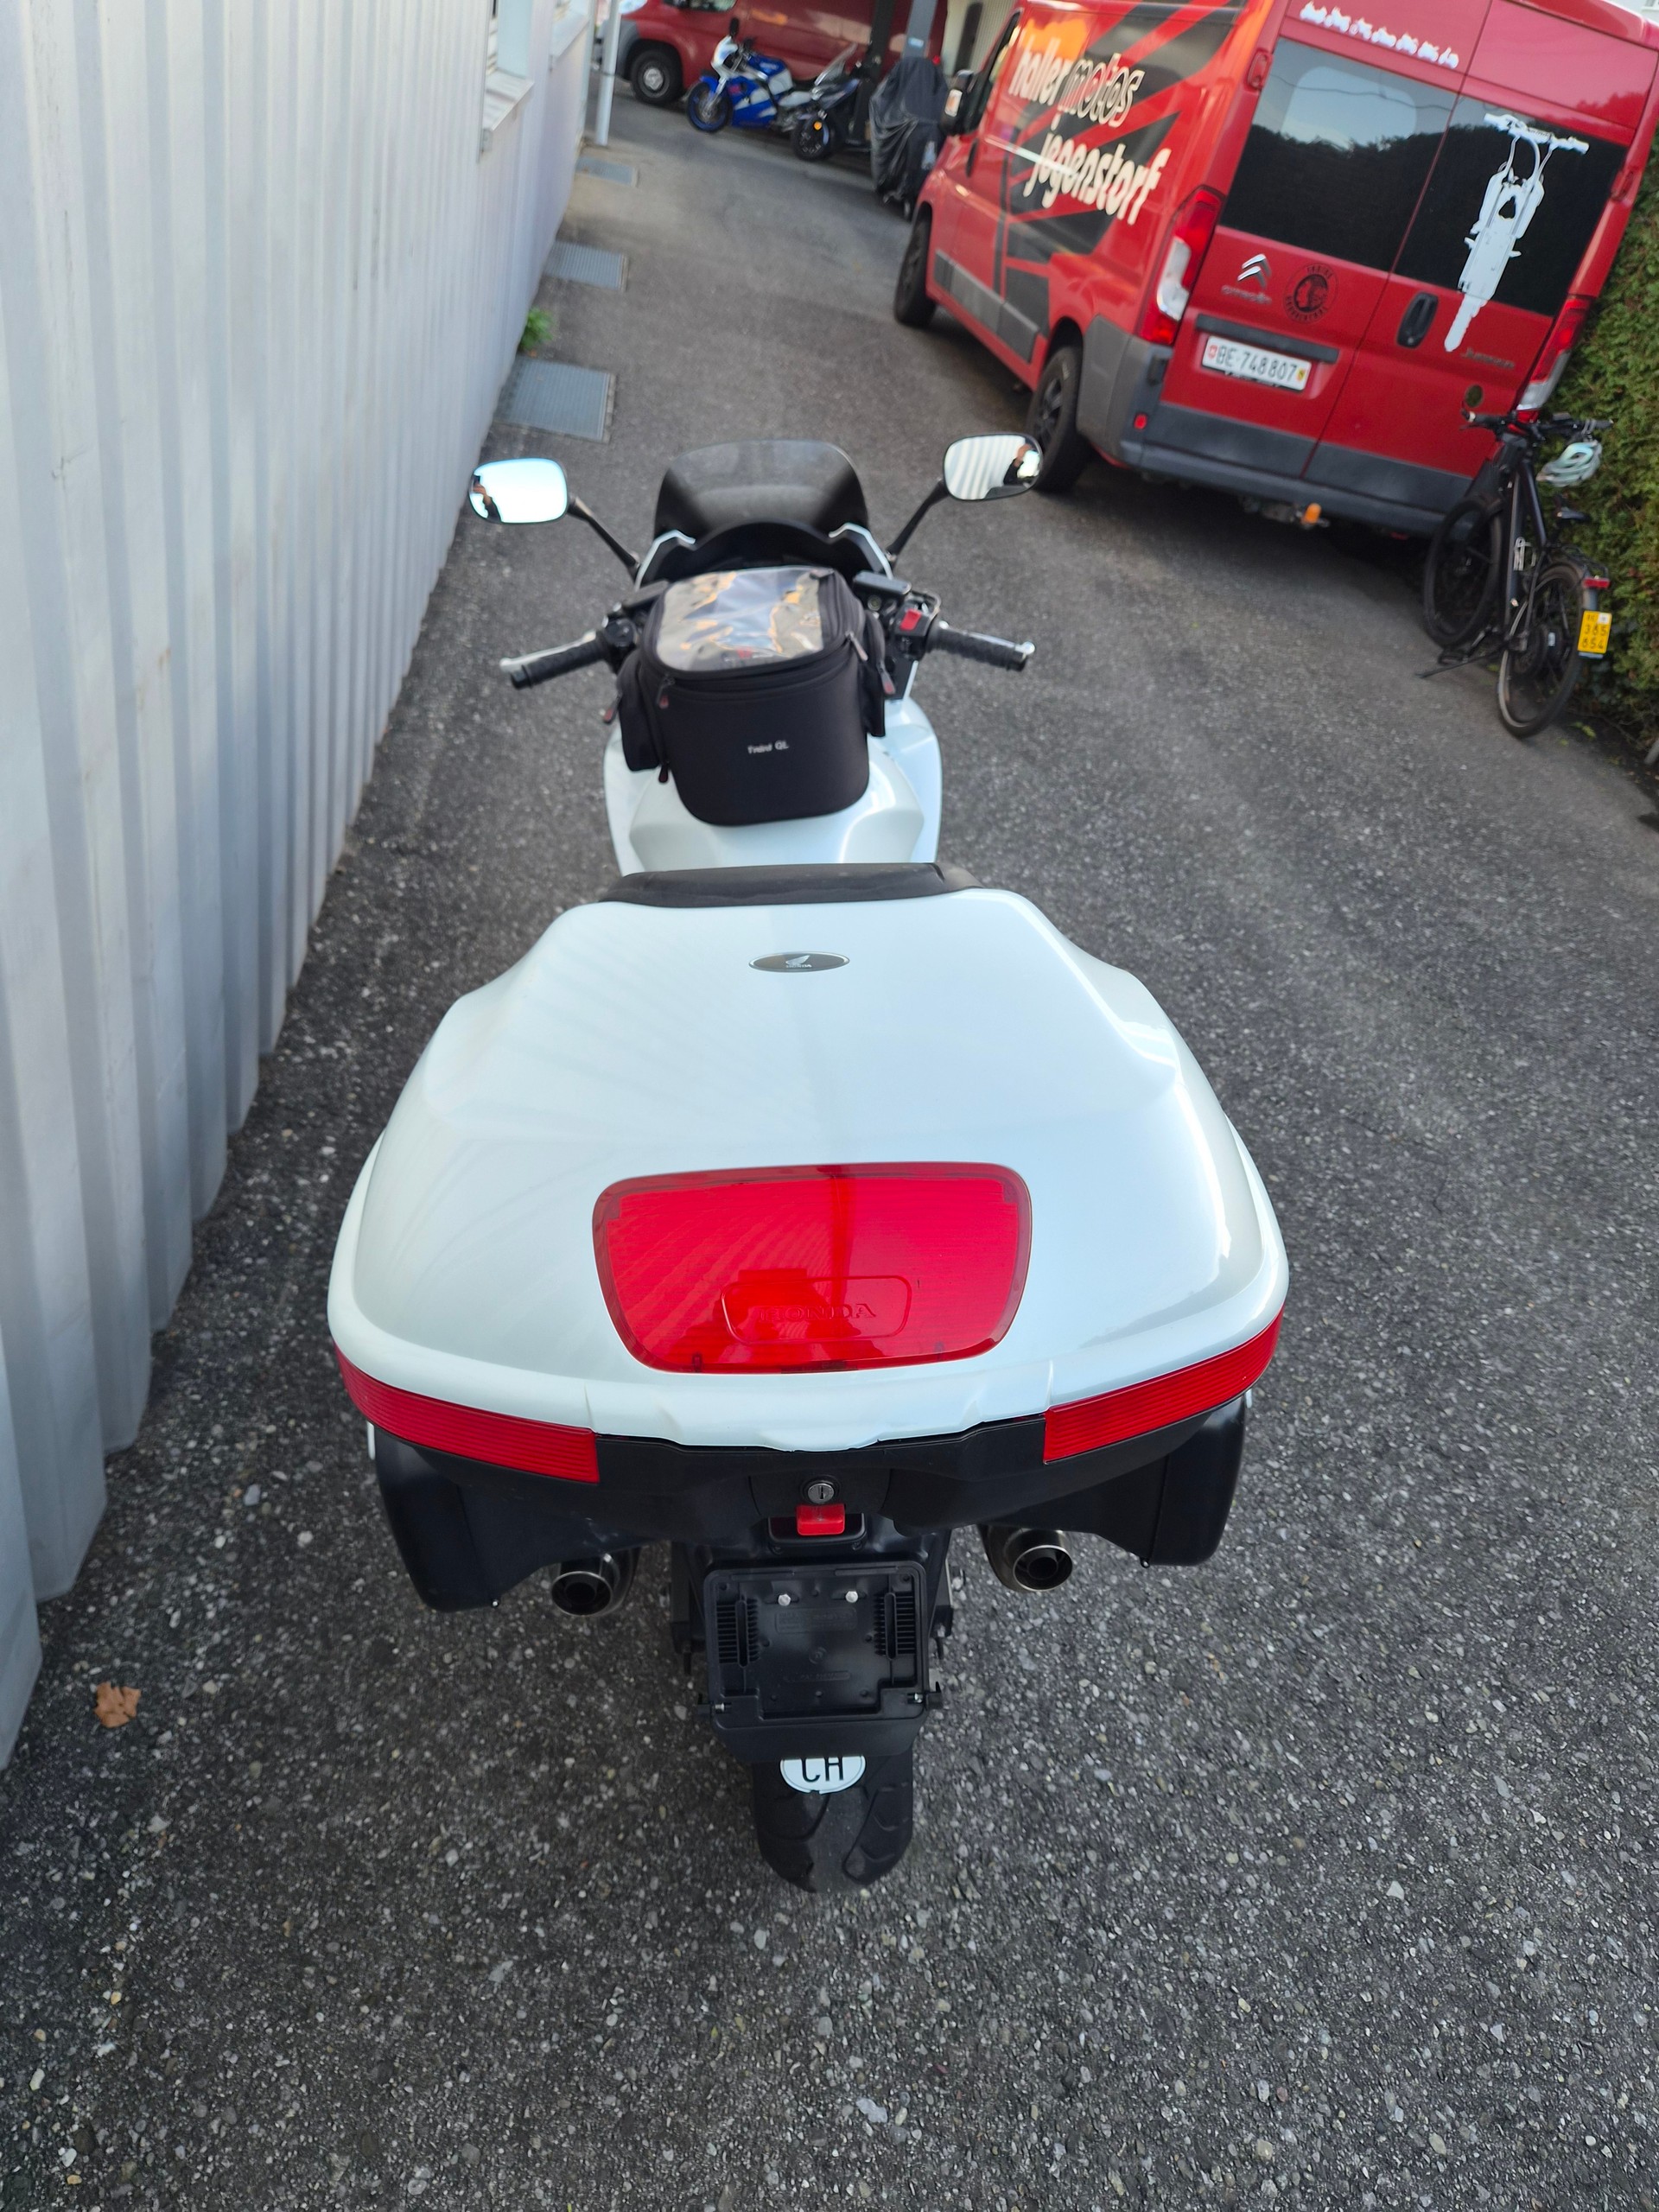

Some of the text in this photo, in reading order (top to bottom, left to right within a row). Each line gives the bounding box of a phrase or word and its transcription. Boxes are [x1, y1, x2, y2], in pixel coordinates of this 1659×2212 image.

[1008, 35, 1146, 128] haller motos
[1023, 113, 1172, 226] jegenstorf
[759, 1303, 877, 1323] HONDA
[801, 1757, 844, 1783] CH
